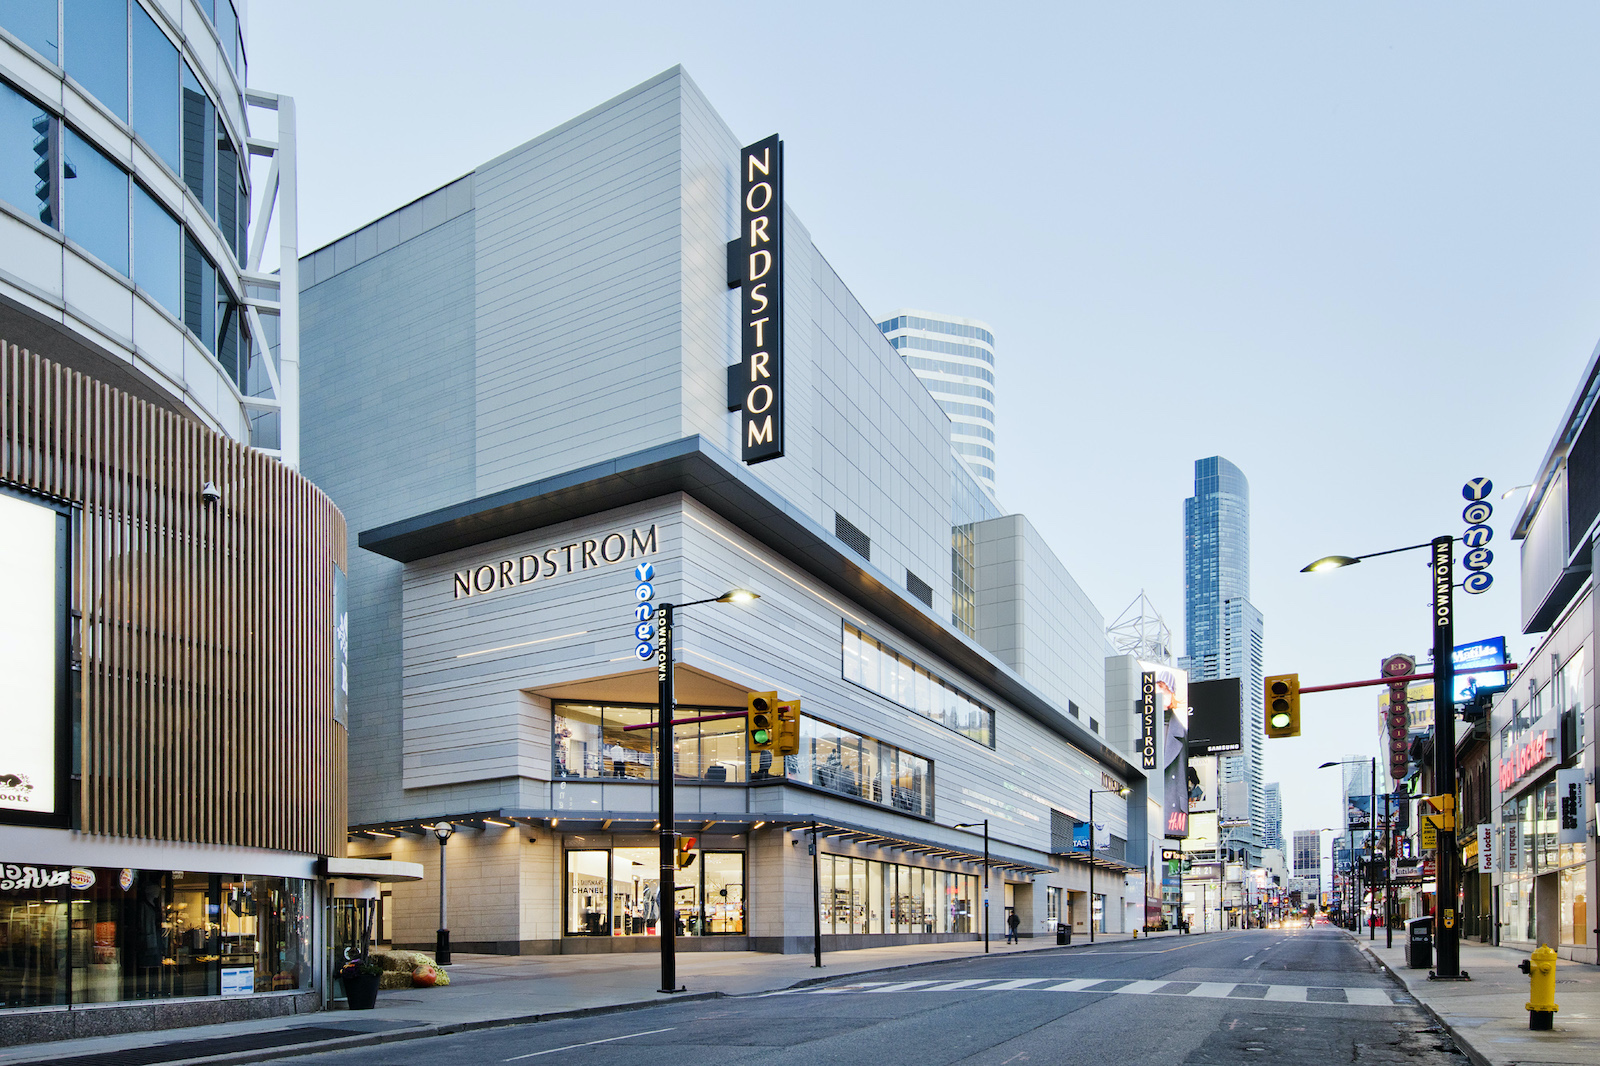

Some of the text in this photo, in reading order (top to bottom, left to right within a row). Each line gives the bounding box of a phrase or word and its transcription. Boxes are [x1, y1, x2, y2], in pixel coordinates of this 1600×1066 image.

[745, 147, 773, 448] NORDSTROM
[454, 524, 659, 599] NORDSTROM
[1463, 477, 1493, 594] Yonge
[635, 562, 654, 661] Yonge
[1437, 542, 1449, 627] DOWNTOWN
[658, 609, 667, 682] DOWNTOWN
[1390, 662, 1407, 671] ED
[1143, 673, 1155, 767] NORDSTROM
[1207, 743, 1240, 752] SAMSUNG
[1499, 730, 1547, 793] Foot Locker
[1168, 811, 1187, 832] H&M
[1483, 827, 1492, 870] Foot Locker
[1203, 866, 1213, 875] 21
